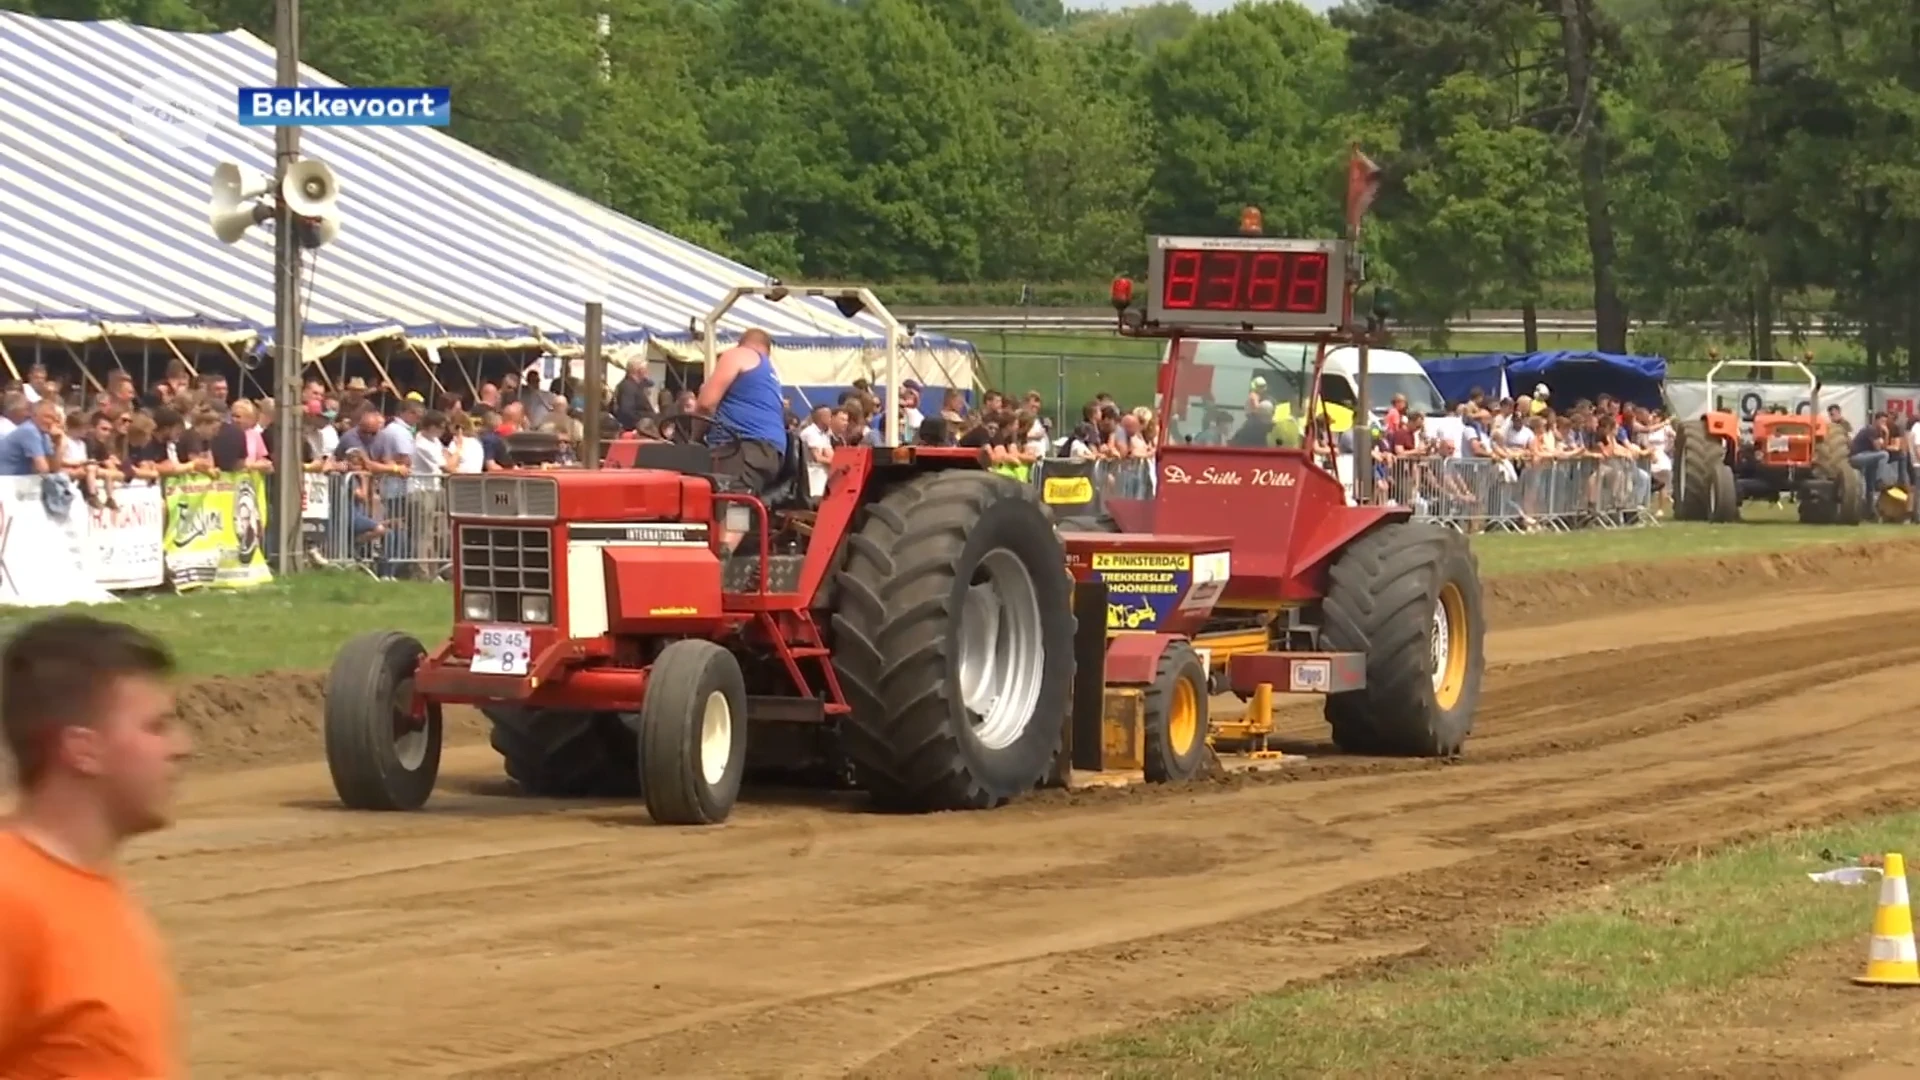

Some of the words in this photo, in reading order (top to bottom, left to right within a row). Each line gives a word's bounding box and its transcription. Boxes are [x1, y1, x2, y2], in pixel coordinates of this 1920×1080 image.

[1164, 465, 1192, 484] De
[1195, 467, 1242, 485] Stille
[1251, 469, 1296, 487] Wille
[626, 528, 685, 541] INTERNATIONAL
[1097, 555, 1110, 566] 2e
[1112, 556, 1185, 567] PINKSTERDAG
[1101, 572, 1174, 582] TREKKERSLEP
[1107, 584, 1178, 594] HOONEBEEK
[483, 632, 502, 646] BS
[505, 634, 522, 647] 45
[502, 651, 515, 672] 8
